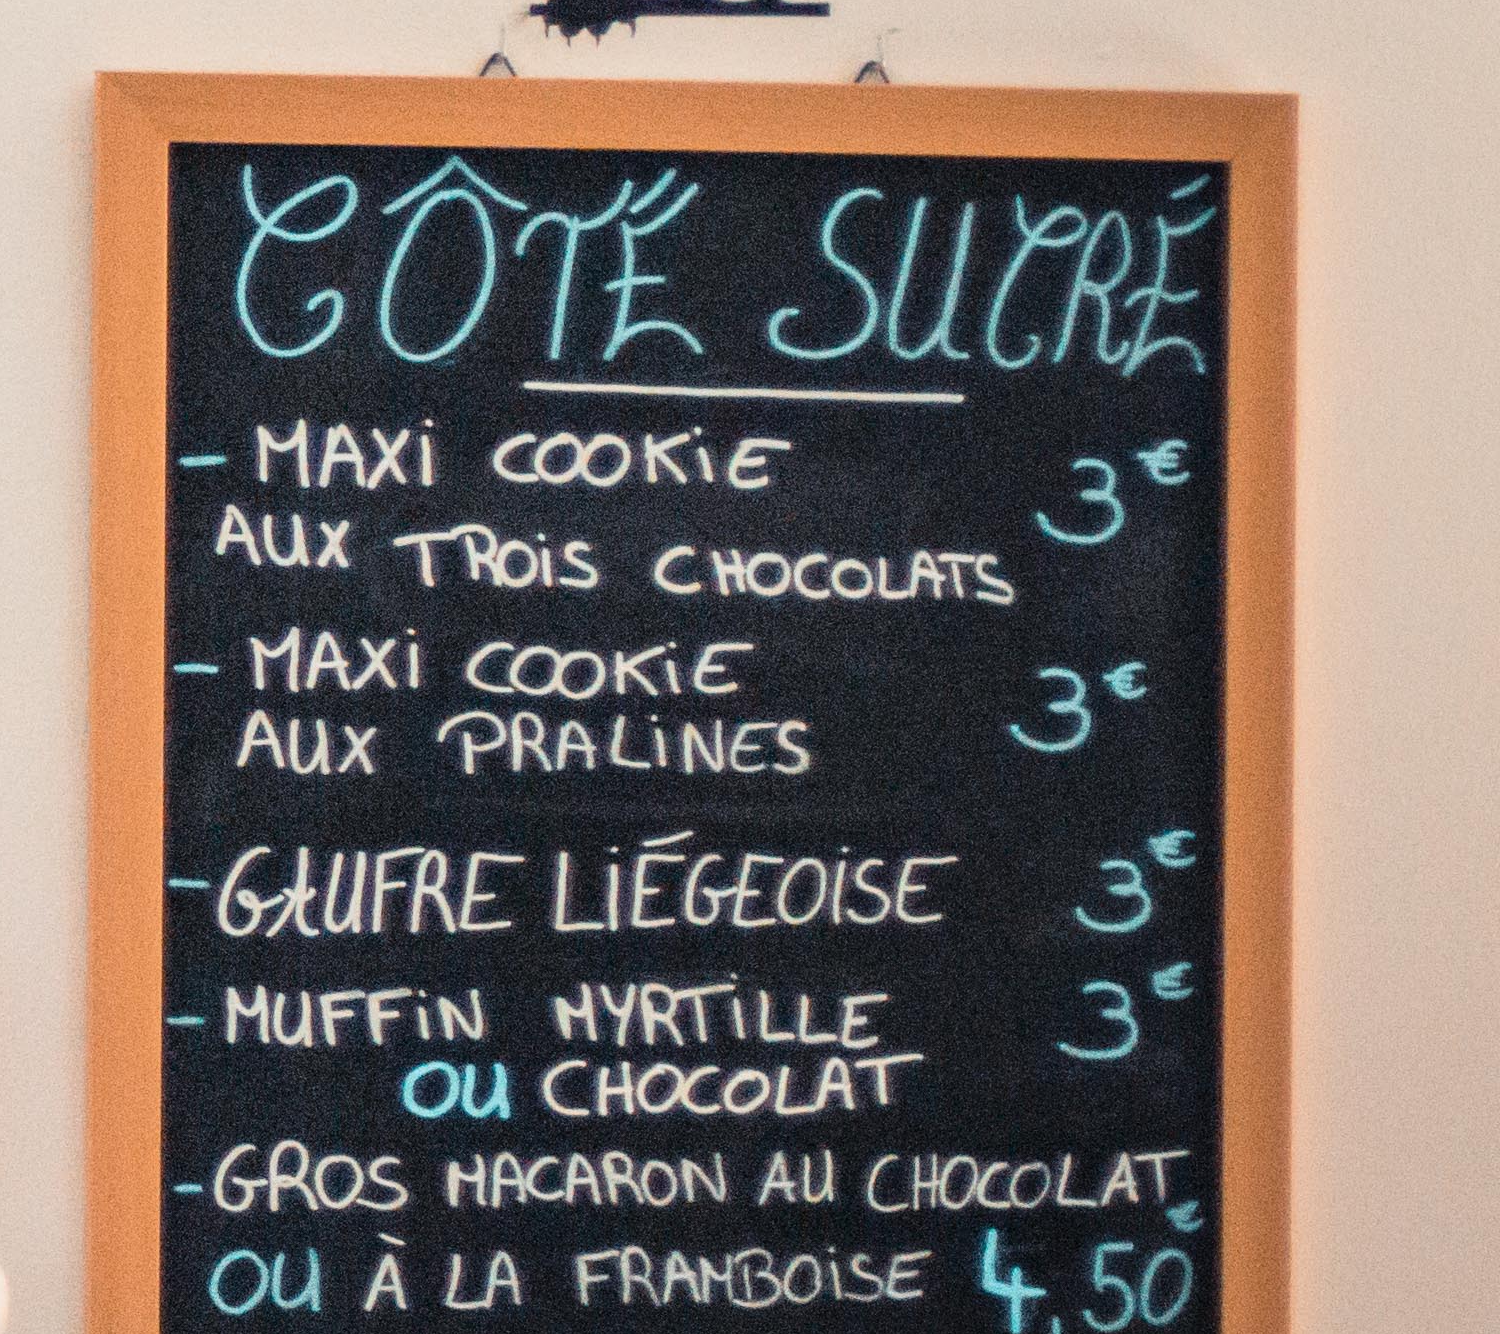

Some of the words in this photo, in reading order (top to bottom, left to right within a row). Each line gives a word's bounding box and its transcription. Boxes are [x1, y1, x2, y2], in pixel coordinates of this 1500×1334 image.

[234, 155, 705, 364] CÔTÉ
[765, 177, 1215, 377] SUCRÉ
[214, 503, 352, 570] AUX
[651, 543, 1016, 606] CHOCOLATS
[235, 708, 378, 776] AUX
[400, 1060, 512, 1120] OU
[540, 1051, 925, 1118] CHOCOLAT
[445, 1149, 728, 1209] MACARON
[757, 1149, 836, 1206] AU
[864, 1148, 1198, 1218] CHOCOLAT
[207, 1248, 322, 1316] OU
[362, 1232, 408, 1312] À
[443, 1250, 522, 1311] LA
